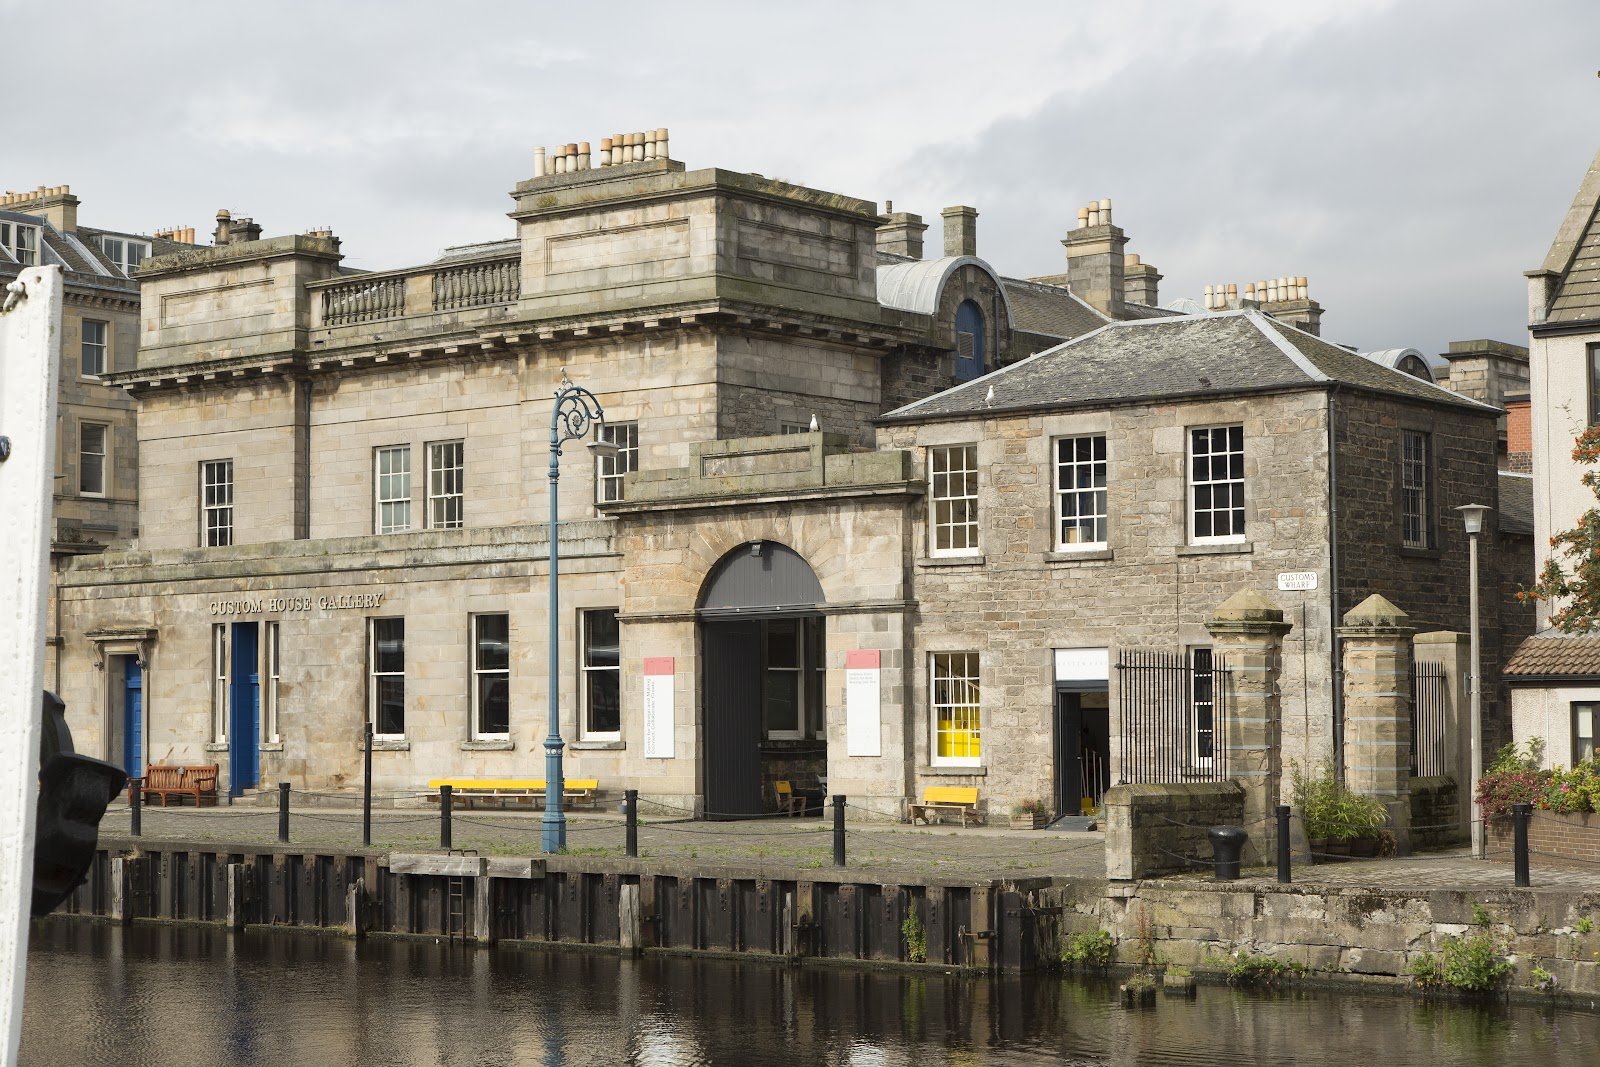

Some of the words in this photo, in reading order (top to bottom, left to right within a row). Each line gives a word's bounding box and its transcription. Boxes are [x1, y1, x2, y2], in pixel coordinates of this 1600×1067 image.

[1280, 573, 1315, 581] CUSTOMS
[209, 600, 262, 615] CUSTOM
[268, 597, 311, 612] HOUSE
[318, 593, 383, 610] GALLERY
